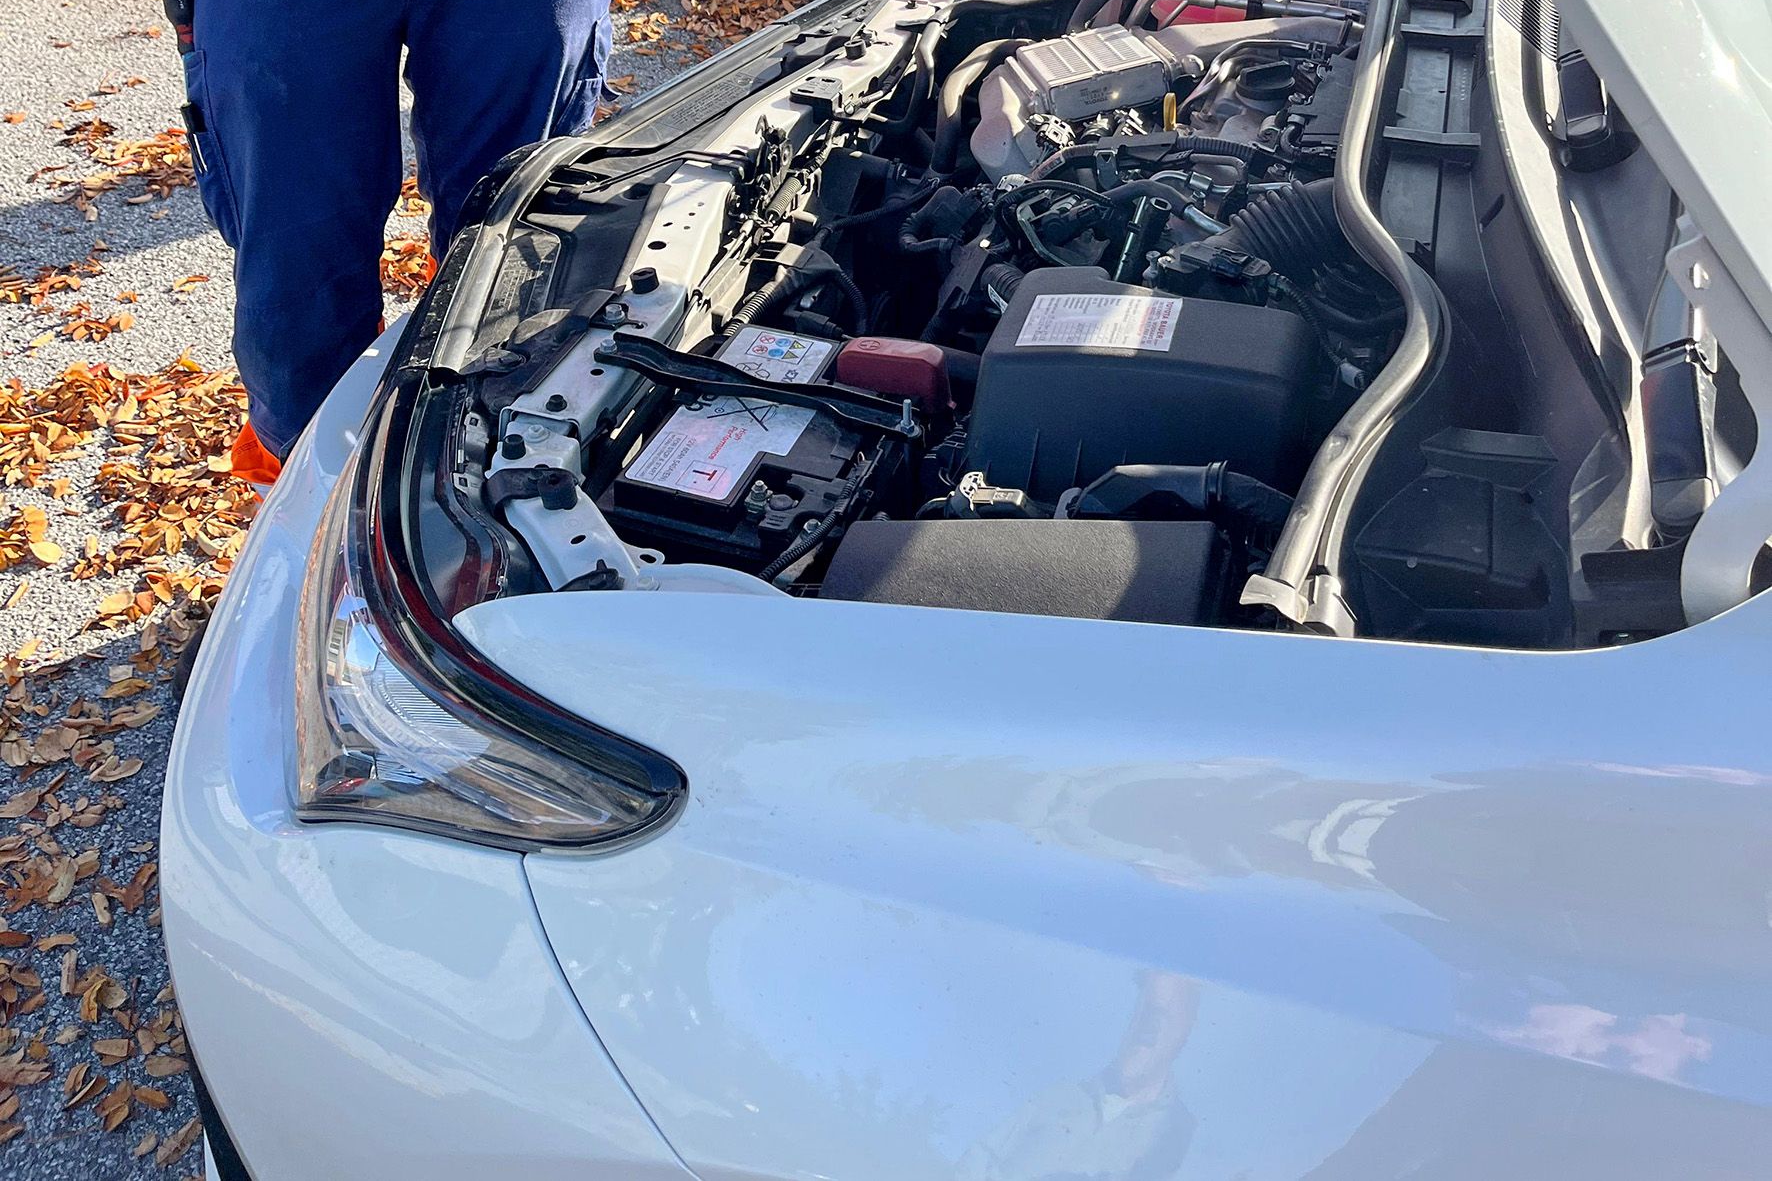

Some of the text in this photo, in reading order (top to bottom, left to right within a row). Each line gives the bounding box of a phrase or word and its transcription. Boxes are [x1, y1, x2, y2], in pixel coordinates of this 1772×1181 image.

[1161, 301, 1174, 320] TOYOTA
[1156, 320, 1168, 339] BAUER
[708, 426, 738, 460] Performance
[733, 427, 748, 441] High
